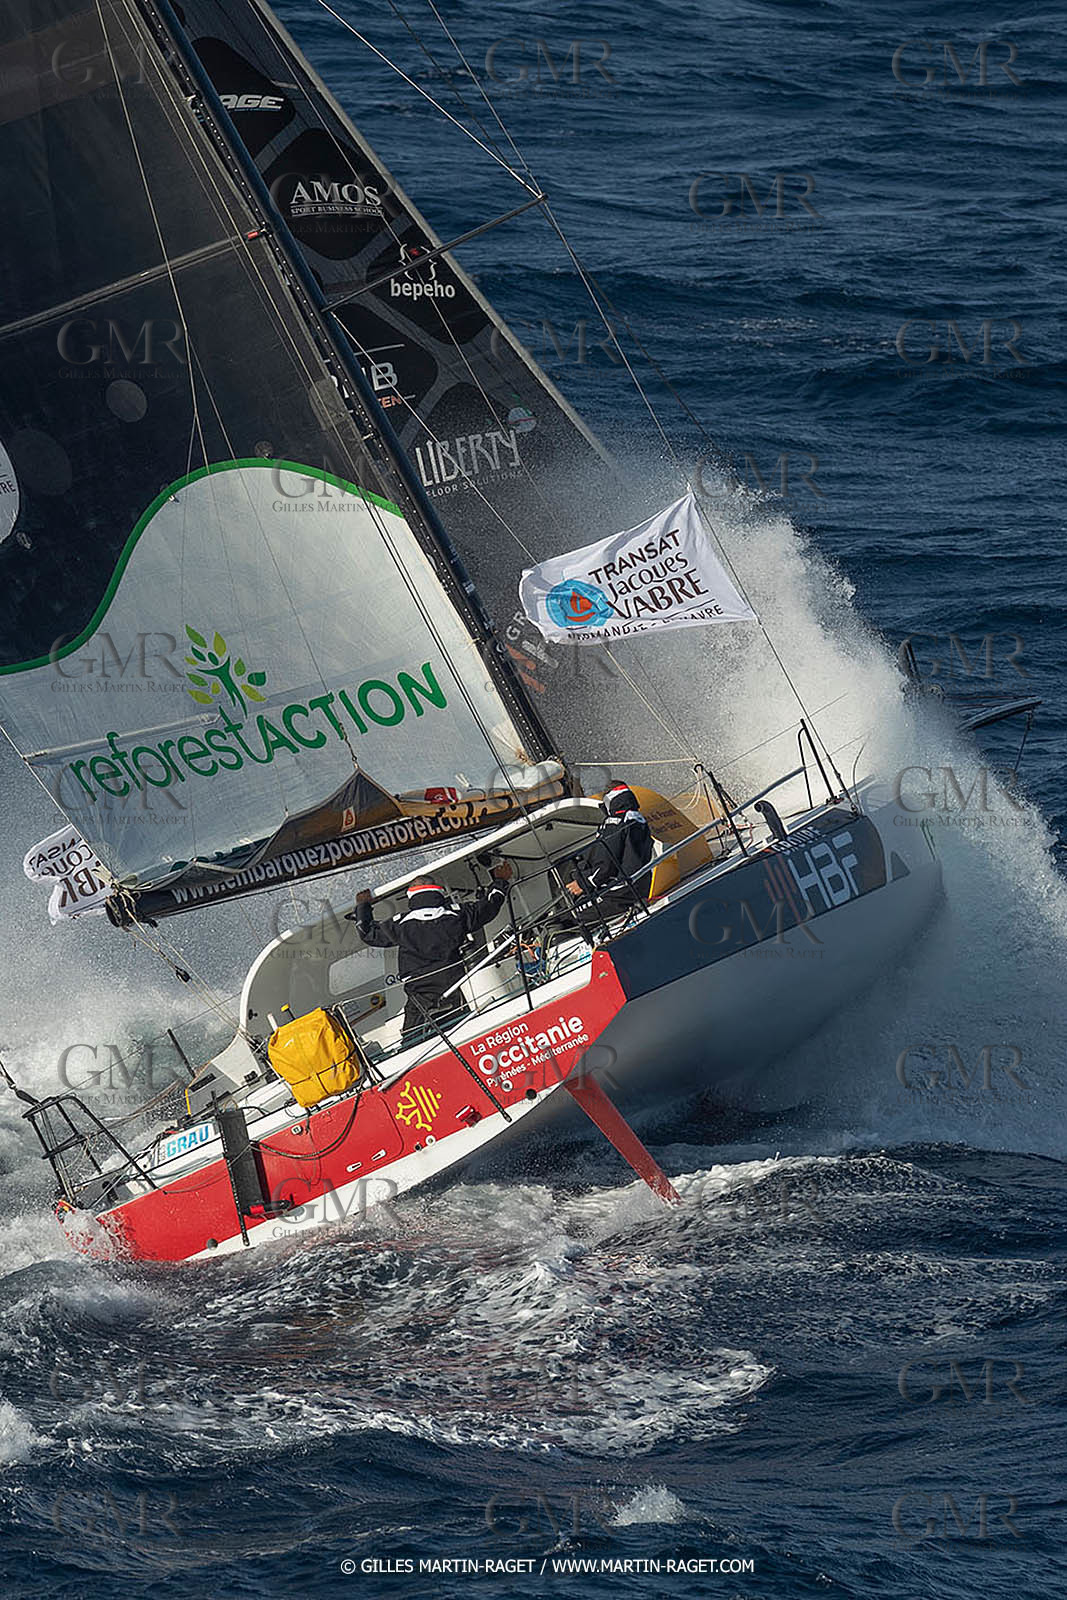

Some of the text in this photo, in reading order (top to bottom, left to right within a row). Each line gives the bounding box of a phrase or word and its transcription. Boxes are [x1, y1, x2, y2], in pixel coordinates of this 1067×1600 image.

[290, 181, 382, 206] AMOS
[390, 279, 456, 301] bepeho
[415, 430, 521, 487] LIBERTY
[589, 529, 681, 585] TRANSAT
[606, 551, 689, 600] Jacques
[606, 568, 709, 620] VABRE
[70, 661, 448, 801] reforestACTION
[787, 831, 860, 916] HBF
[470, 1022, 530, 1056] La Région
[478, 1015, 585, 1076] Occitanie
[486, 1064, 527, 1089] Pyrénées
[531, 1033, 590, 1068] Méditerranée
[166, 1125, 209, 1158] GRAU
